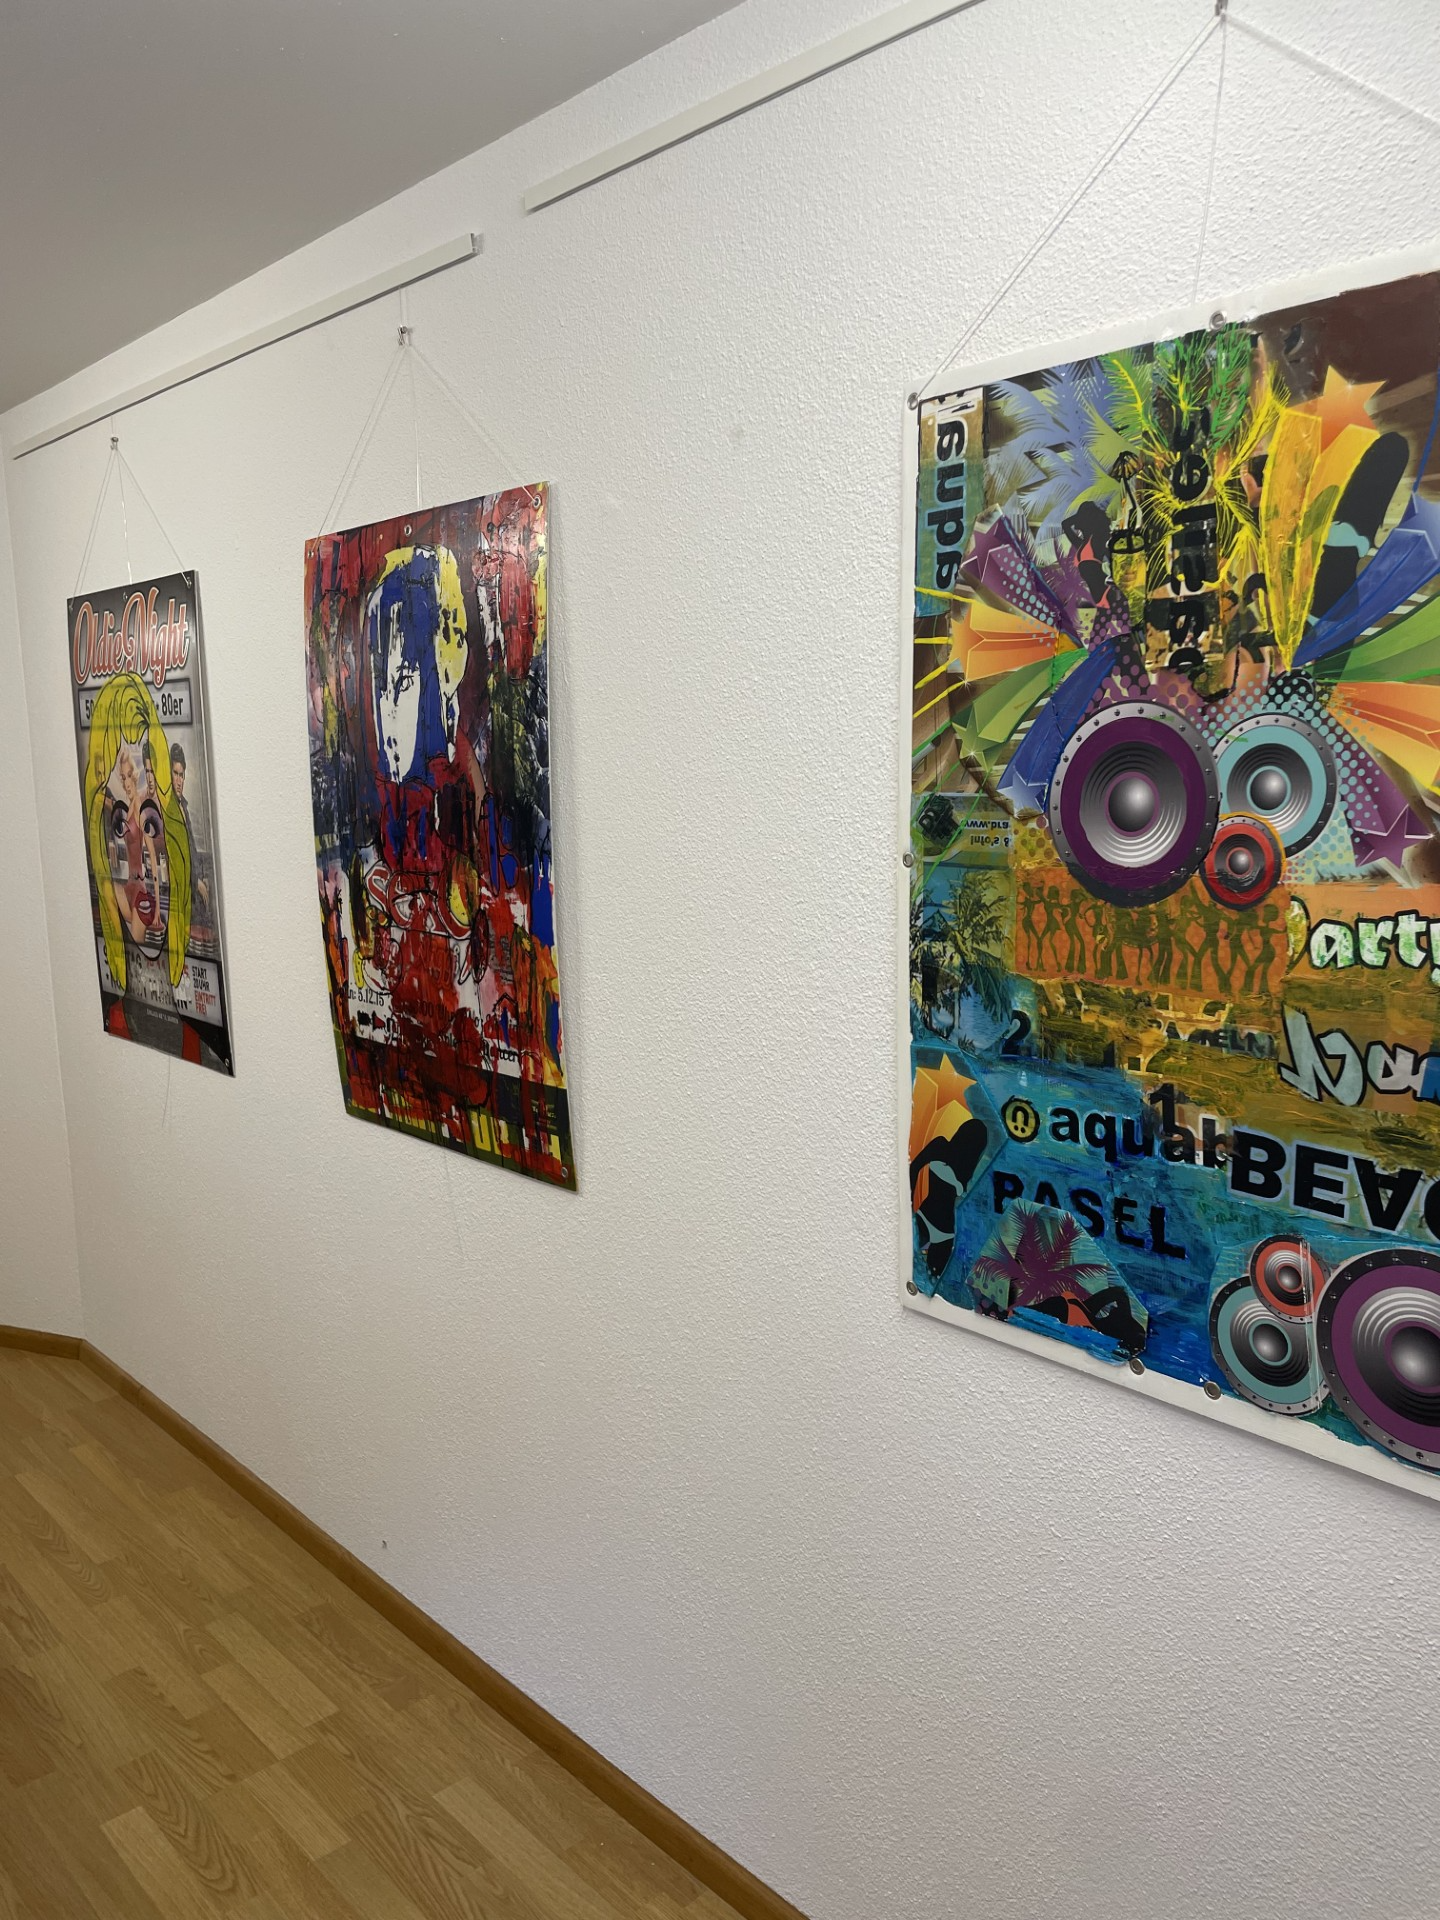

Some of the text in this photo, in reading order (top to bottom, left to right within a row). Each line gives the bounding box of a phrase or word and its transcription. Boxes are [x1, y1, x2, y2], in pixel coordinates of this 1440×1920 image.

[73, 586, 190, 688] Oldie Night
[161, 693, 184, 716] 80er
